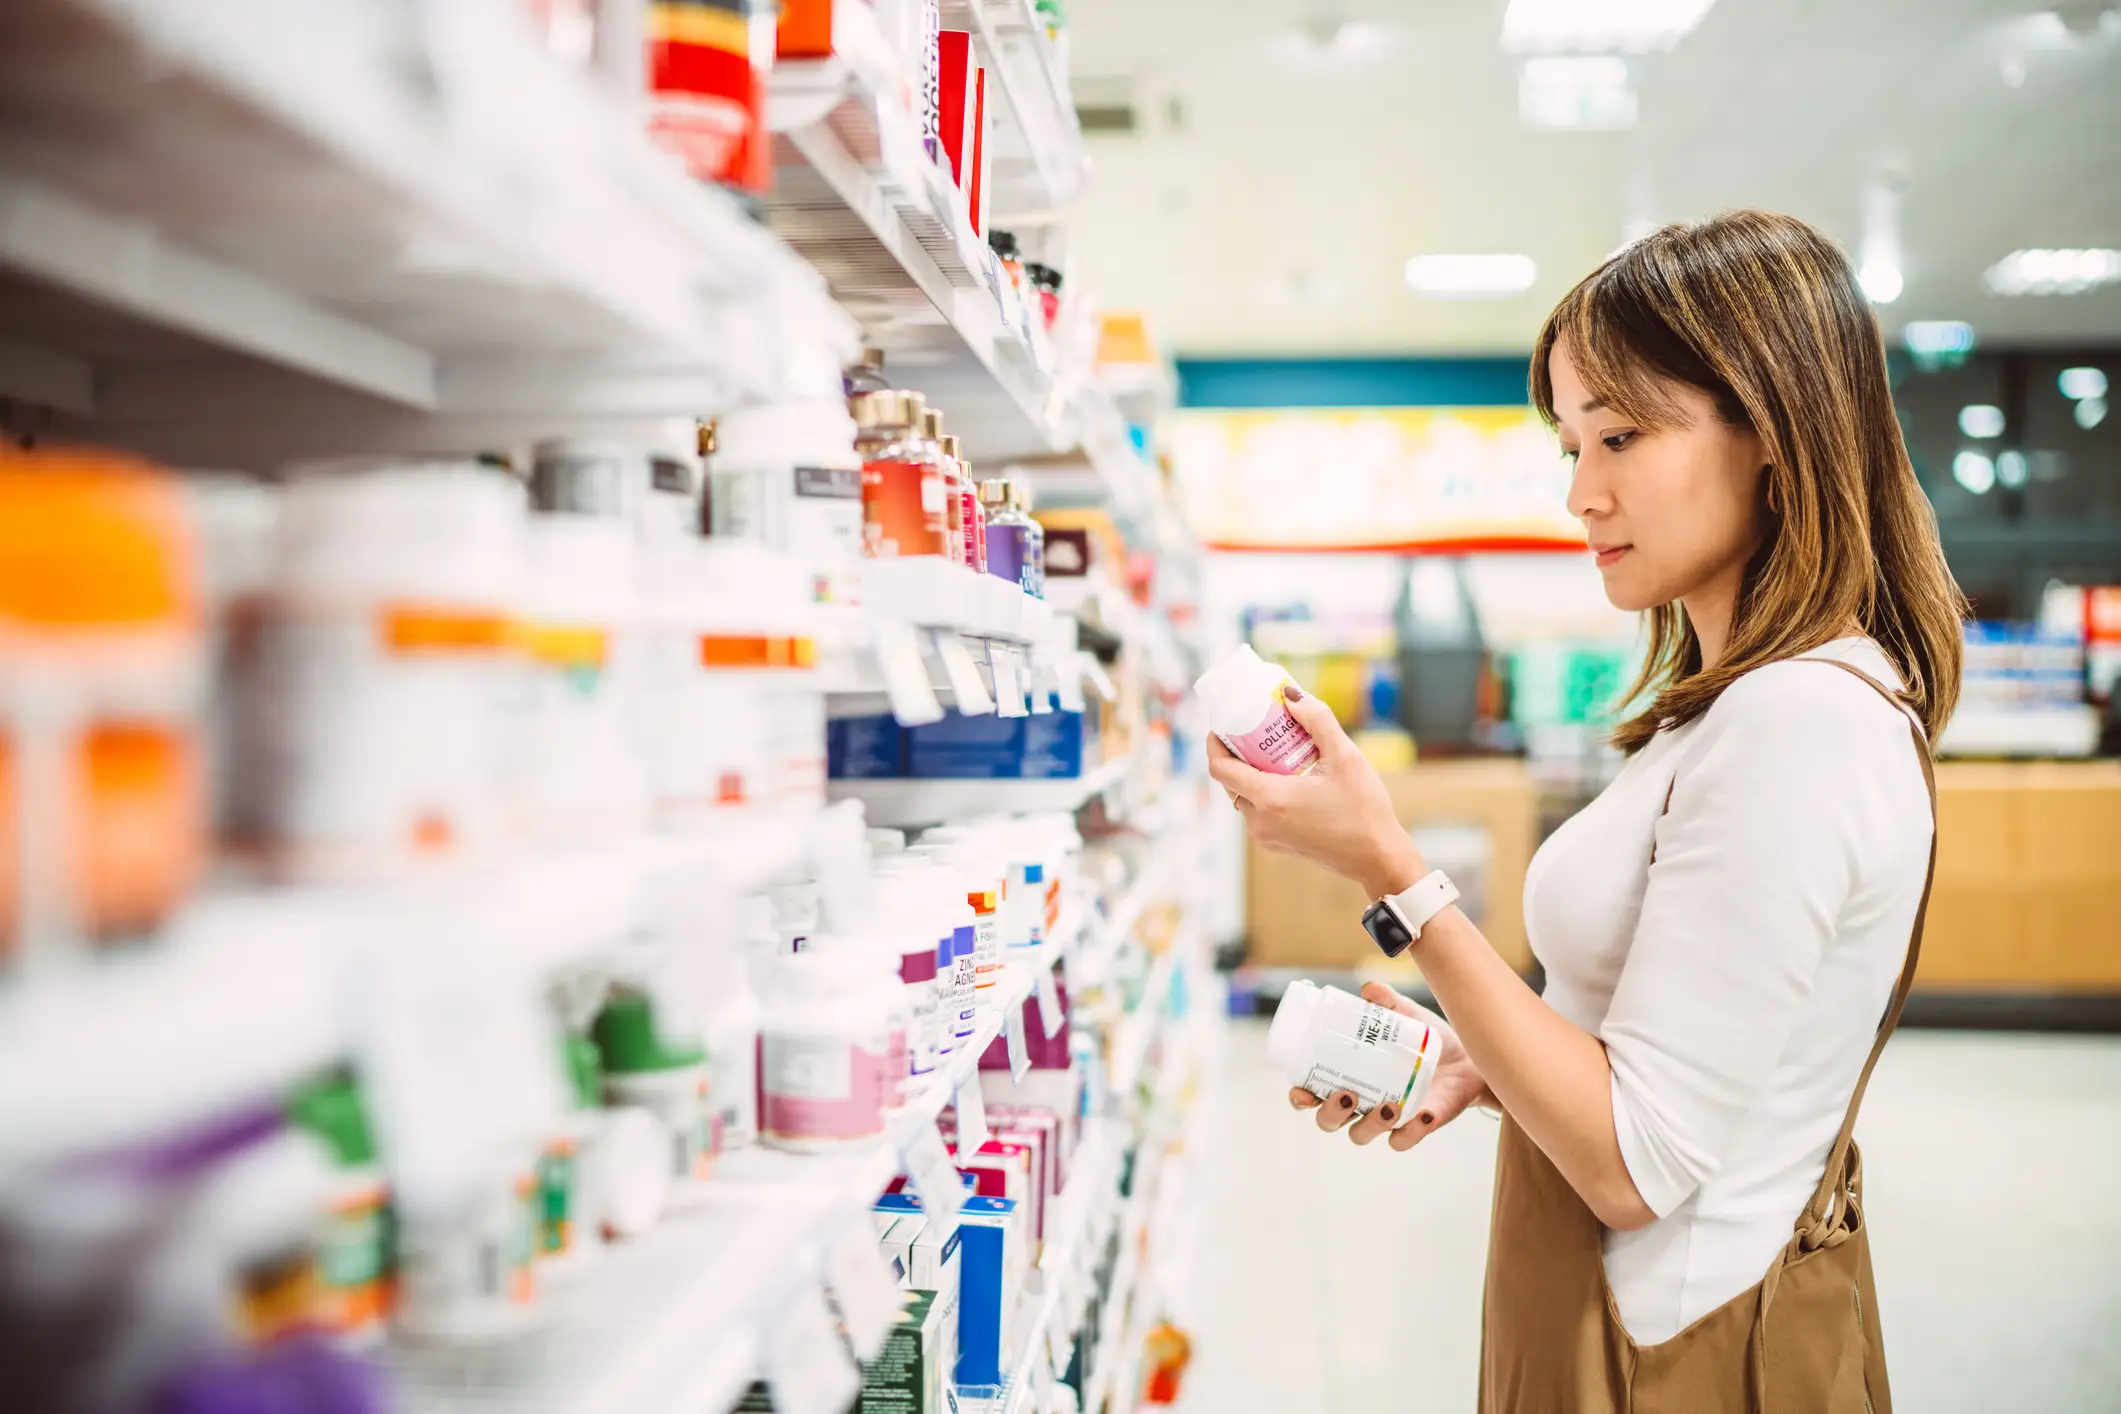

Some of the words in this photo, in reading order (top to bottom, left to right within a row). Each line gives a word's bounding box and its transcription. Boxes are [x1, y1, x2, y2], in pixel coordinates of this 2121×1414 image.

[1265, 713, 1287, 733] BEAUTY
[1259, 716, 1298, 751] COLLAGE
[1269, 741, 1287, 756] VITAMIN
[1381, 1024, 1391, 1041] WITH
